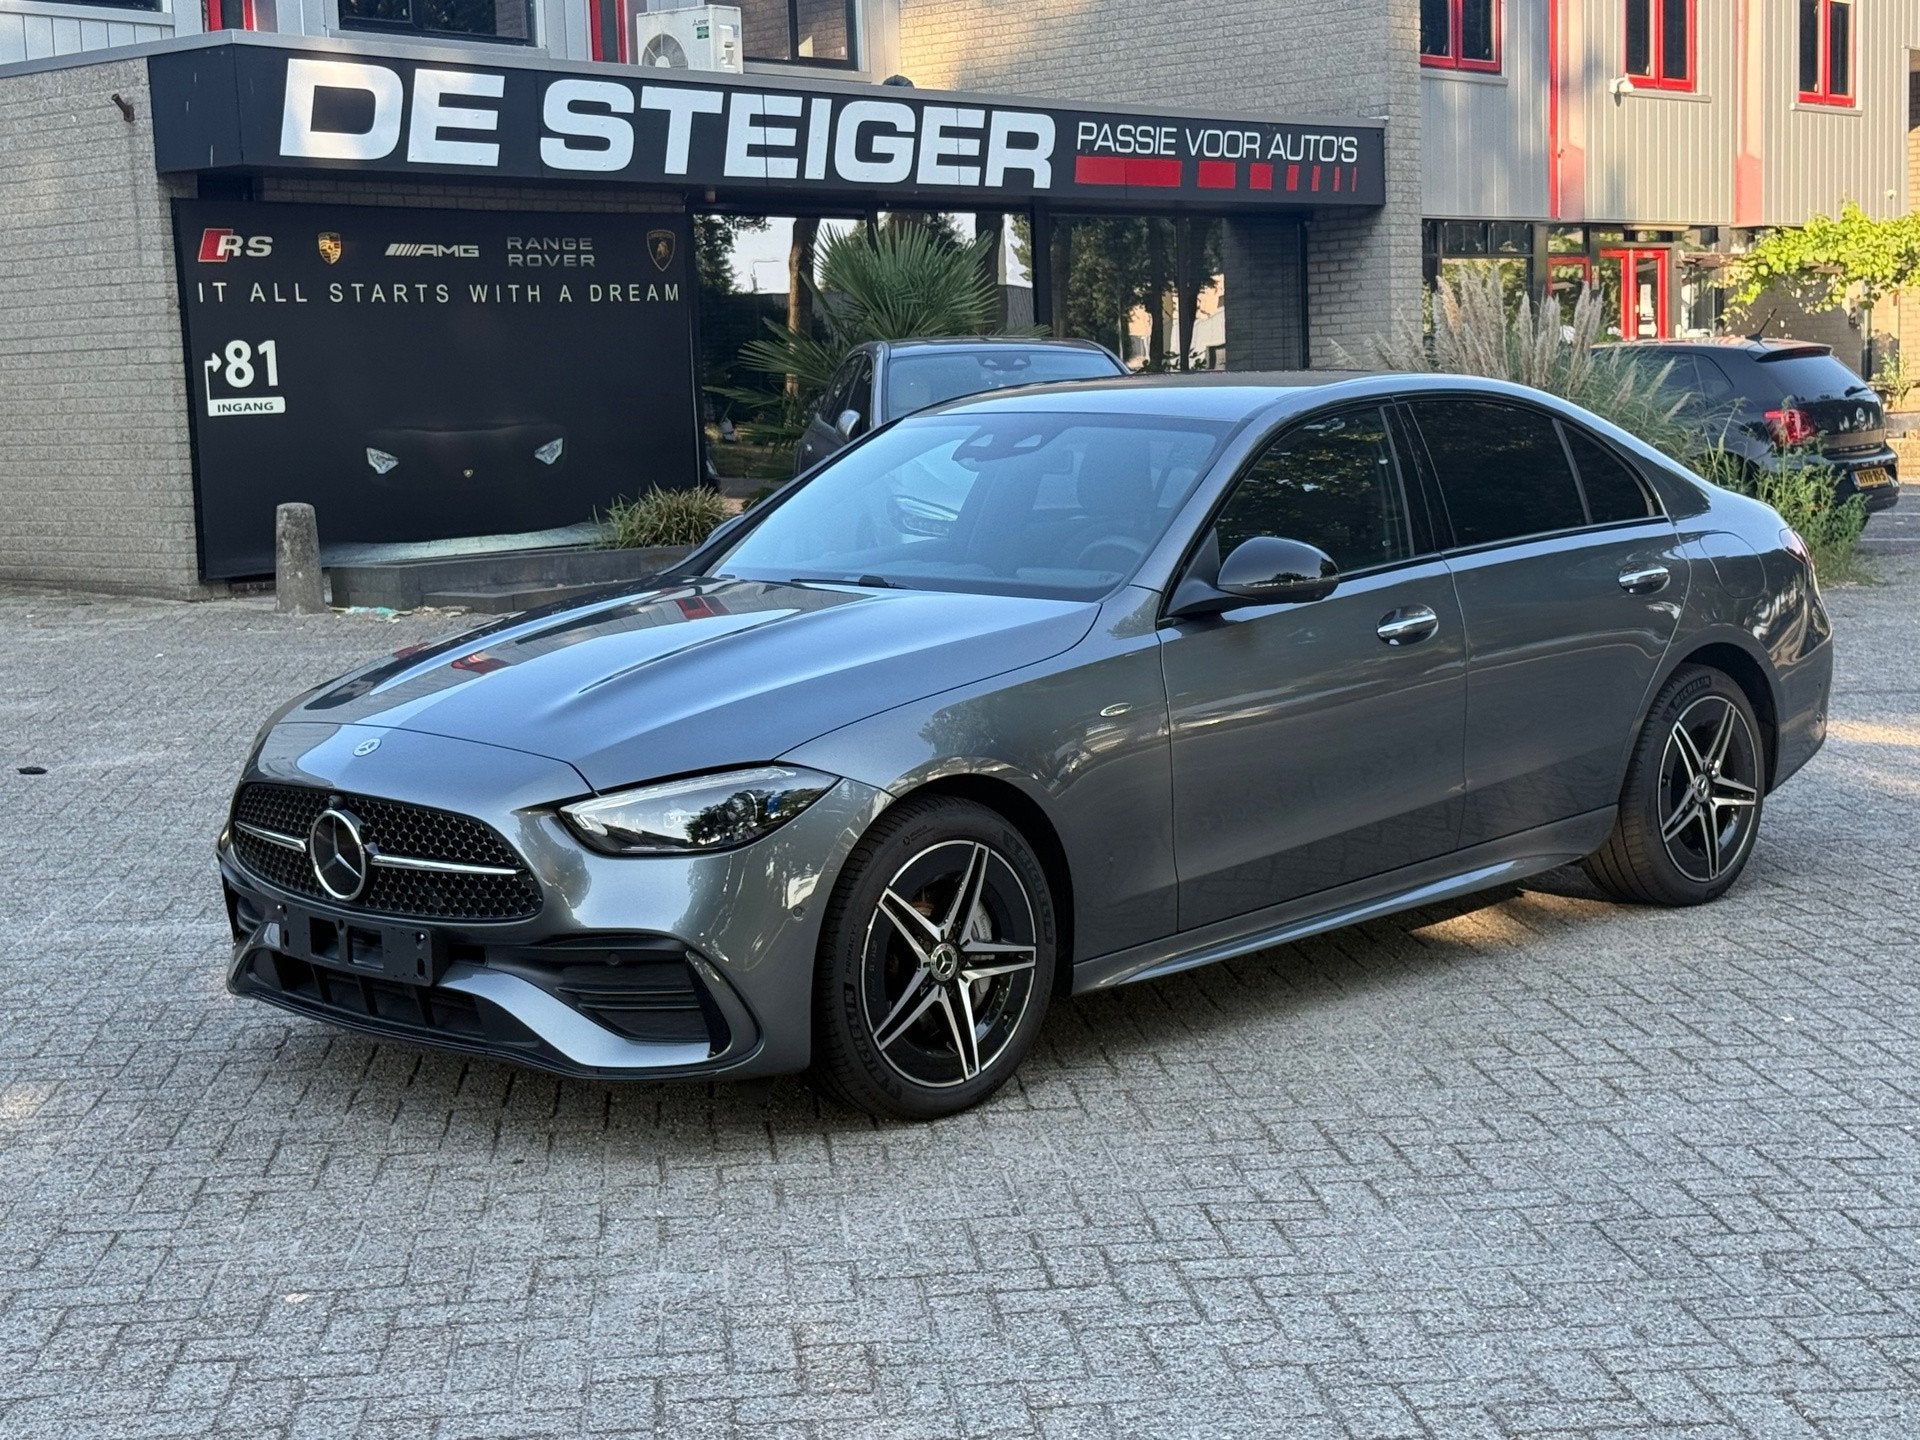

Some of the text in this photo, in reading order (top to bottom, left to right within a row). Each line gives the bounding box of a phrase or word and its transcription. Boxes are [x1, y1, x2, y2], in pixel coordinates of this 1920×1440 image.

[279, 58, 1056, 188] DE STEIGER
[1076, 121, 1358, 163] PASSIE VOOR AUTO'S
[216, 235, 273, 258] RS
[415, 244, 480, 258] AMG
[506, 236, 593, 251] RANGE
[507, 253, 595, 267] ROVER
[198, 282, 679, 303] IT ALL STARTS WITH A DREAM
[224, 339, 279, 388] 81
[216, 401, 275, 413] INGANG
